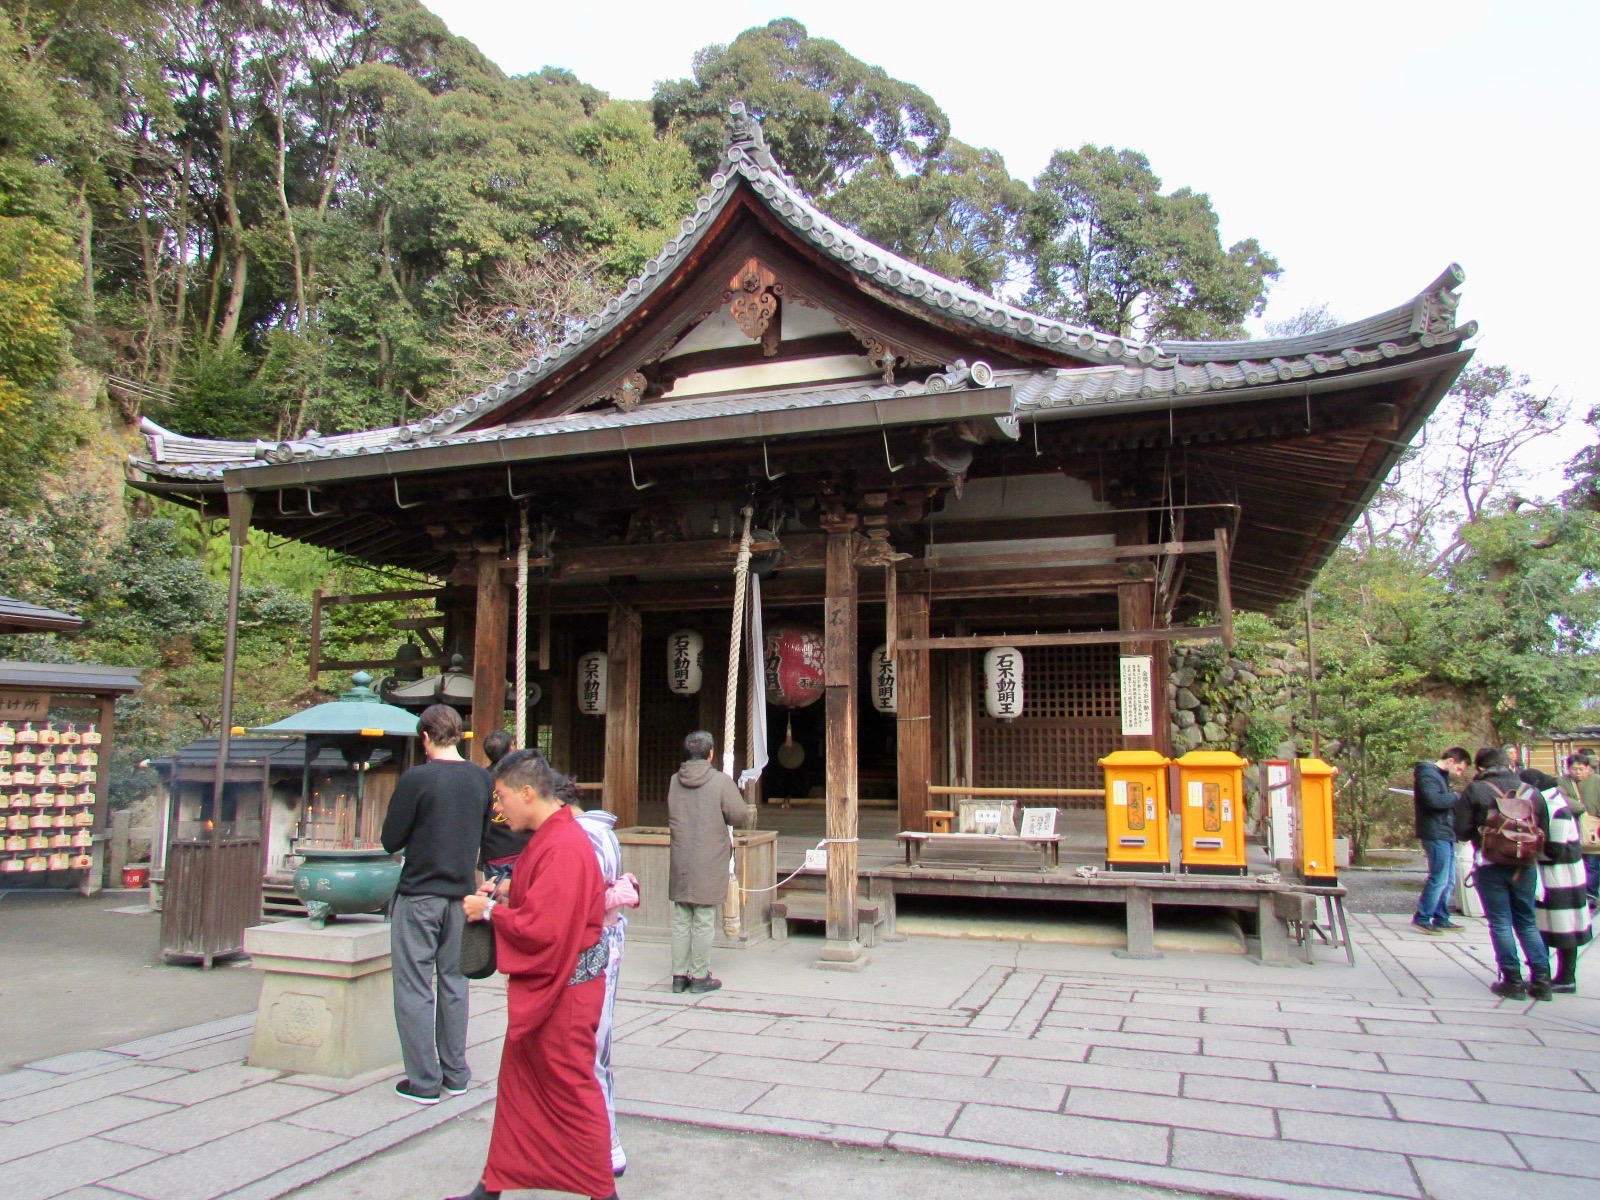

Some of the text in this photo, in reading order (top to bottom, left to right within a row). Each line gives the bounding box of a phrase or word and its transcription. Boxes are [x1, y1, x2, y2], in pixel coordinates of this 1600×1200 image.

[583, 658, 600, 712] 石不動明王
[673, 635, 691, 690] 石不動明王
[877, 651, 895, 709] 石不動明王
[995, 653, 1016, 715] 石不動明王
